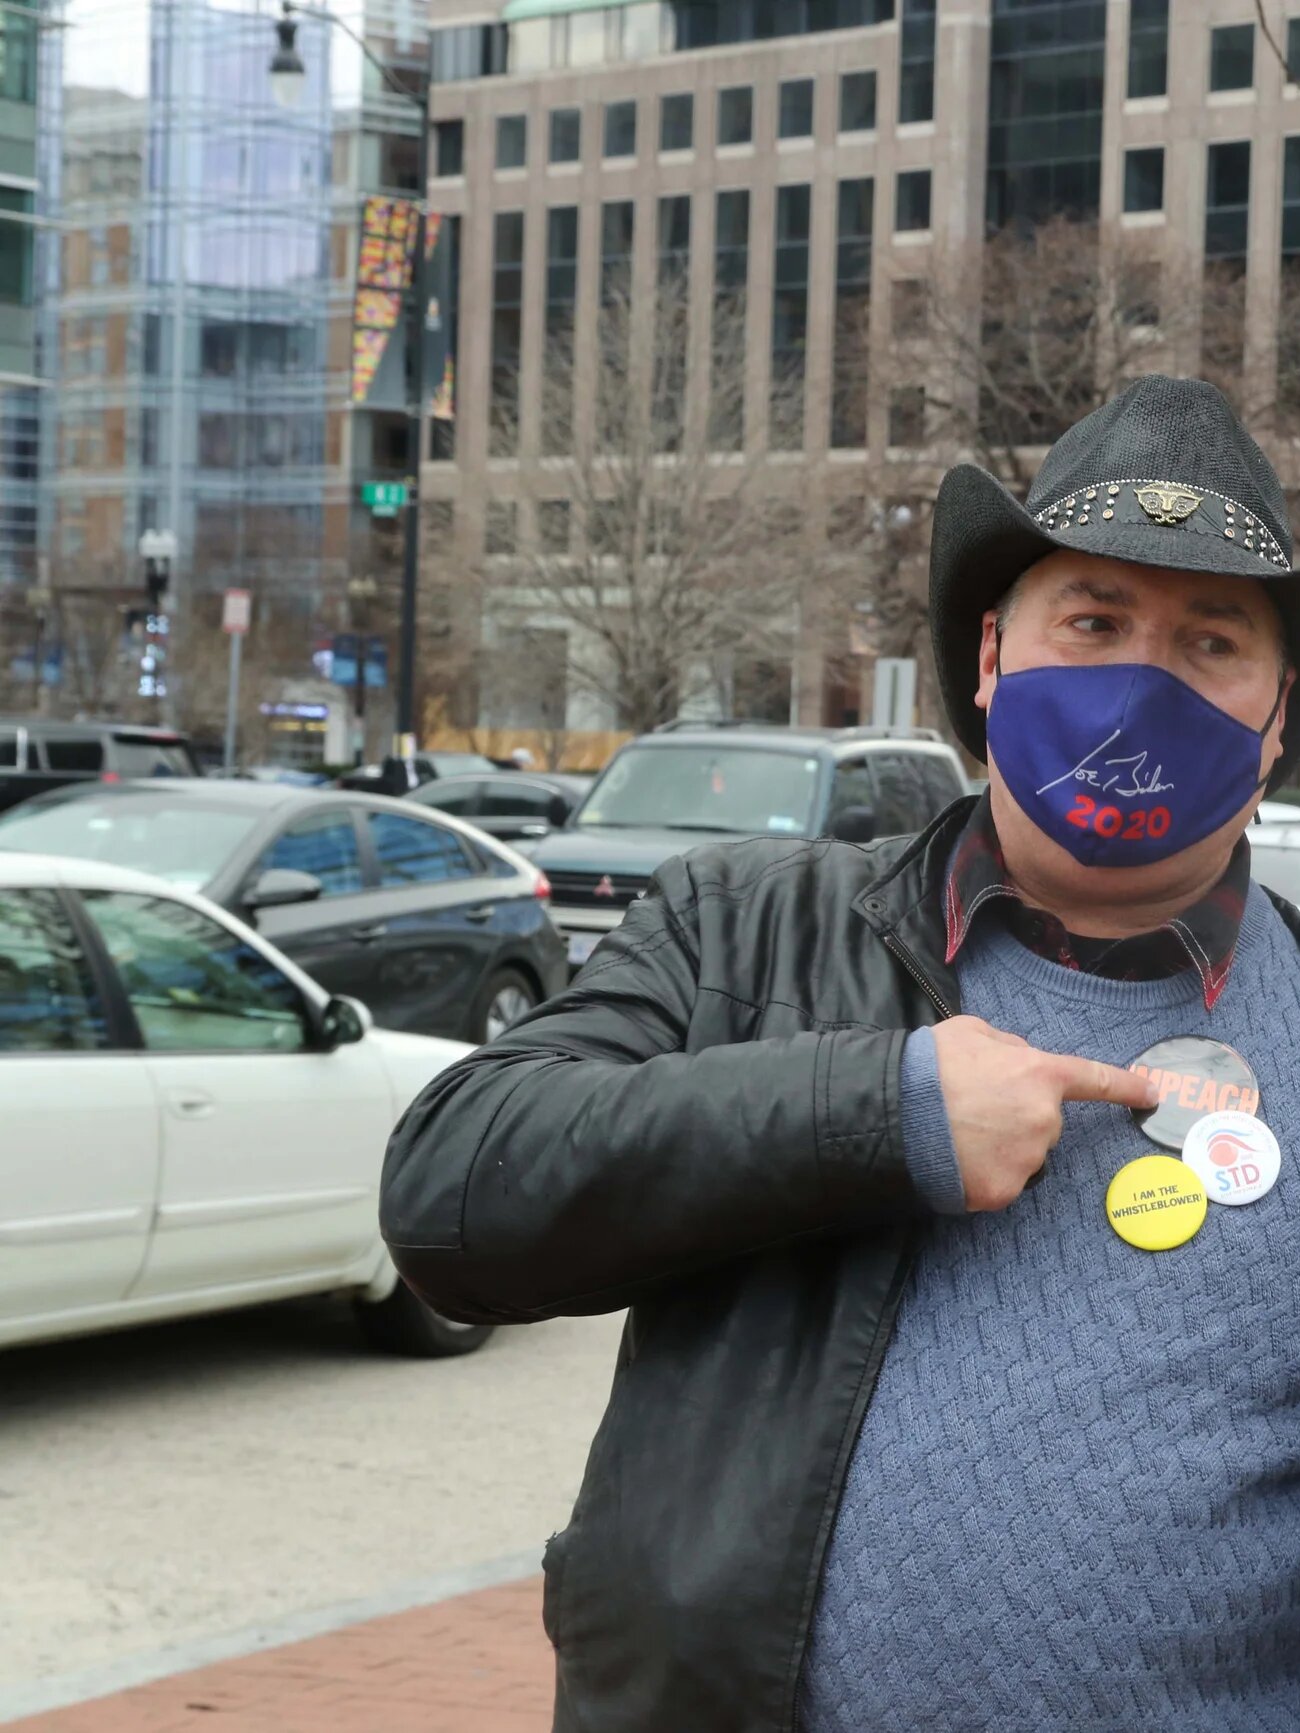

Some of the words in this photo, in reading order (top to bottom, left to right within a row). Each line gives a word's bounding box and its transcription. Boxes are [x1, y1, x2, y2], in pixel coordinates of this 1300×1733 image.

[1102, 750, 1175, 797] Biden
[1065, 794, 1172, 841] 2020
[1129, 1063, 1259, 1117] MPEACH
[1140, 1189, 1156, 1201] AM
[1158, 1184, 1179, 1197] THE
[1215, 1163, 1261, 1192] STD
